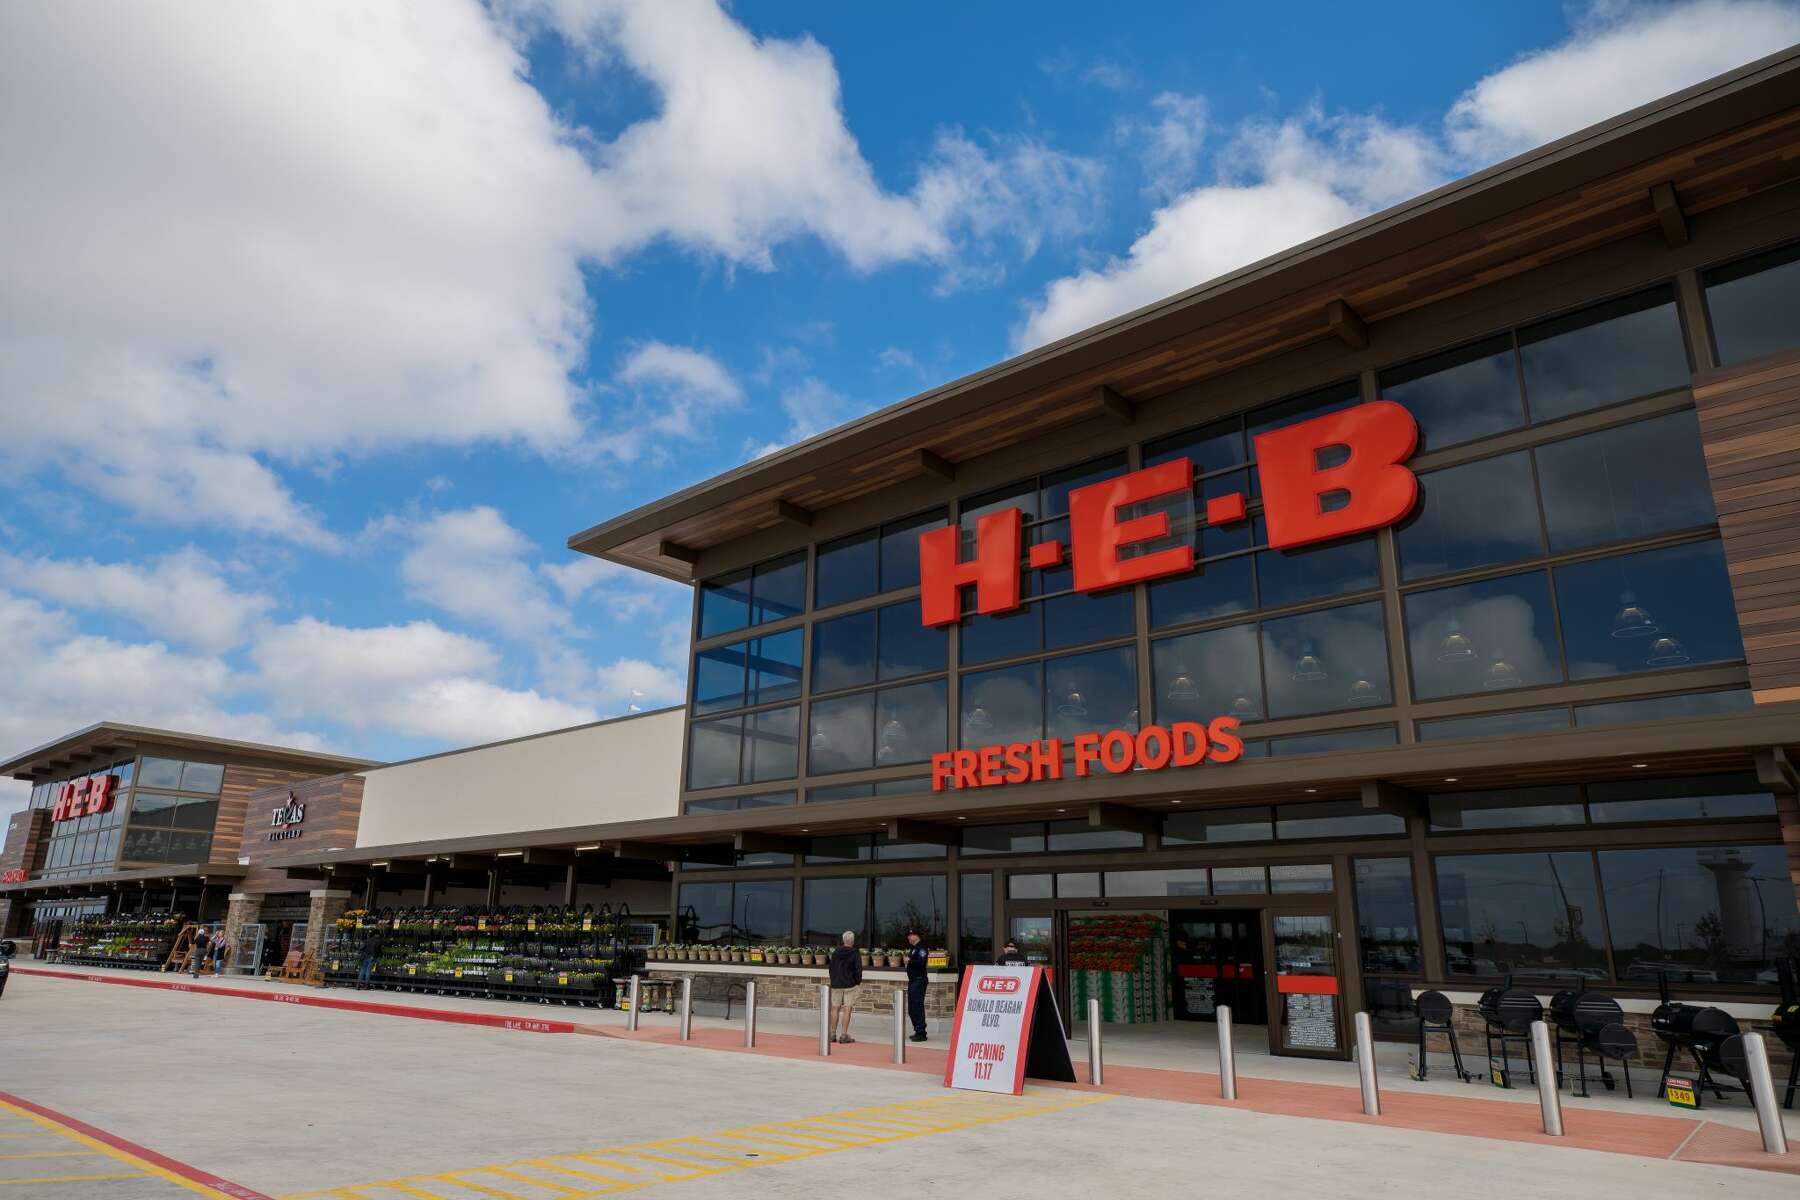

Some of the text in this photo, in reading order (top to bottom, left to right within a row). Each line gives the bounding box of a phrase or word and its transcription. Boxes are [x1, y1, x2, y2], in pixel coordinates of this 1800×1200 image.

[919, 400, 1418, 628] H-E-B
[931, 716, 1244, 792] FRESH FOODS
[967, 999, 1022, 1014] RONALD REAGAN
[981, 1013, 1000, 1028] BLVD.
[967, 1042, 1005, 1061] OPENING
[974, 1062, 993, 1081] 11.17
